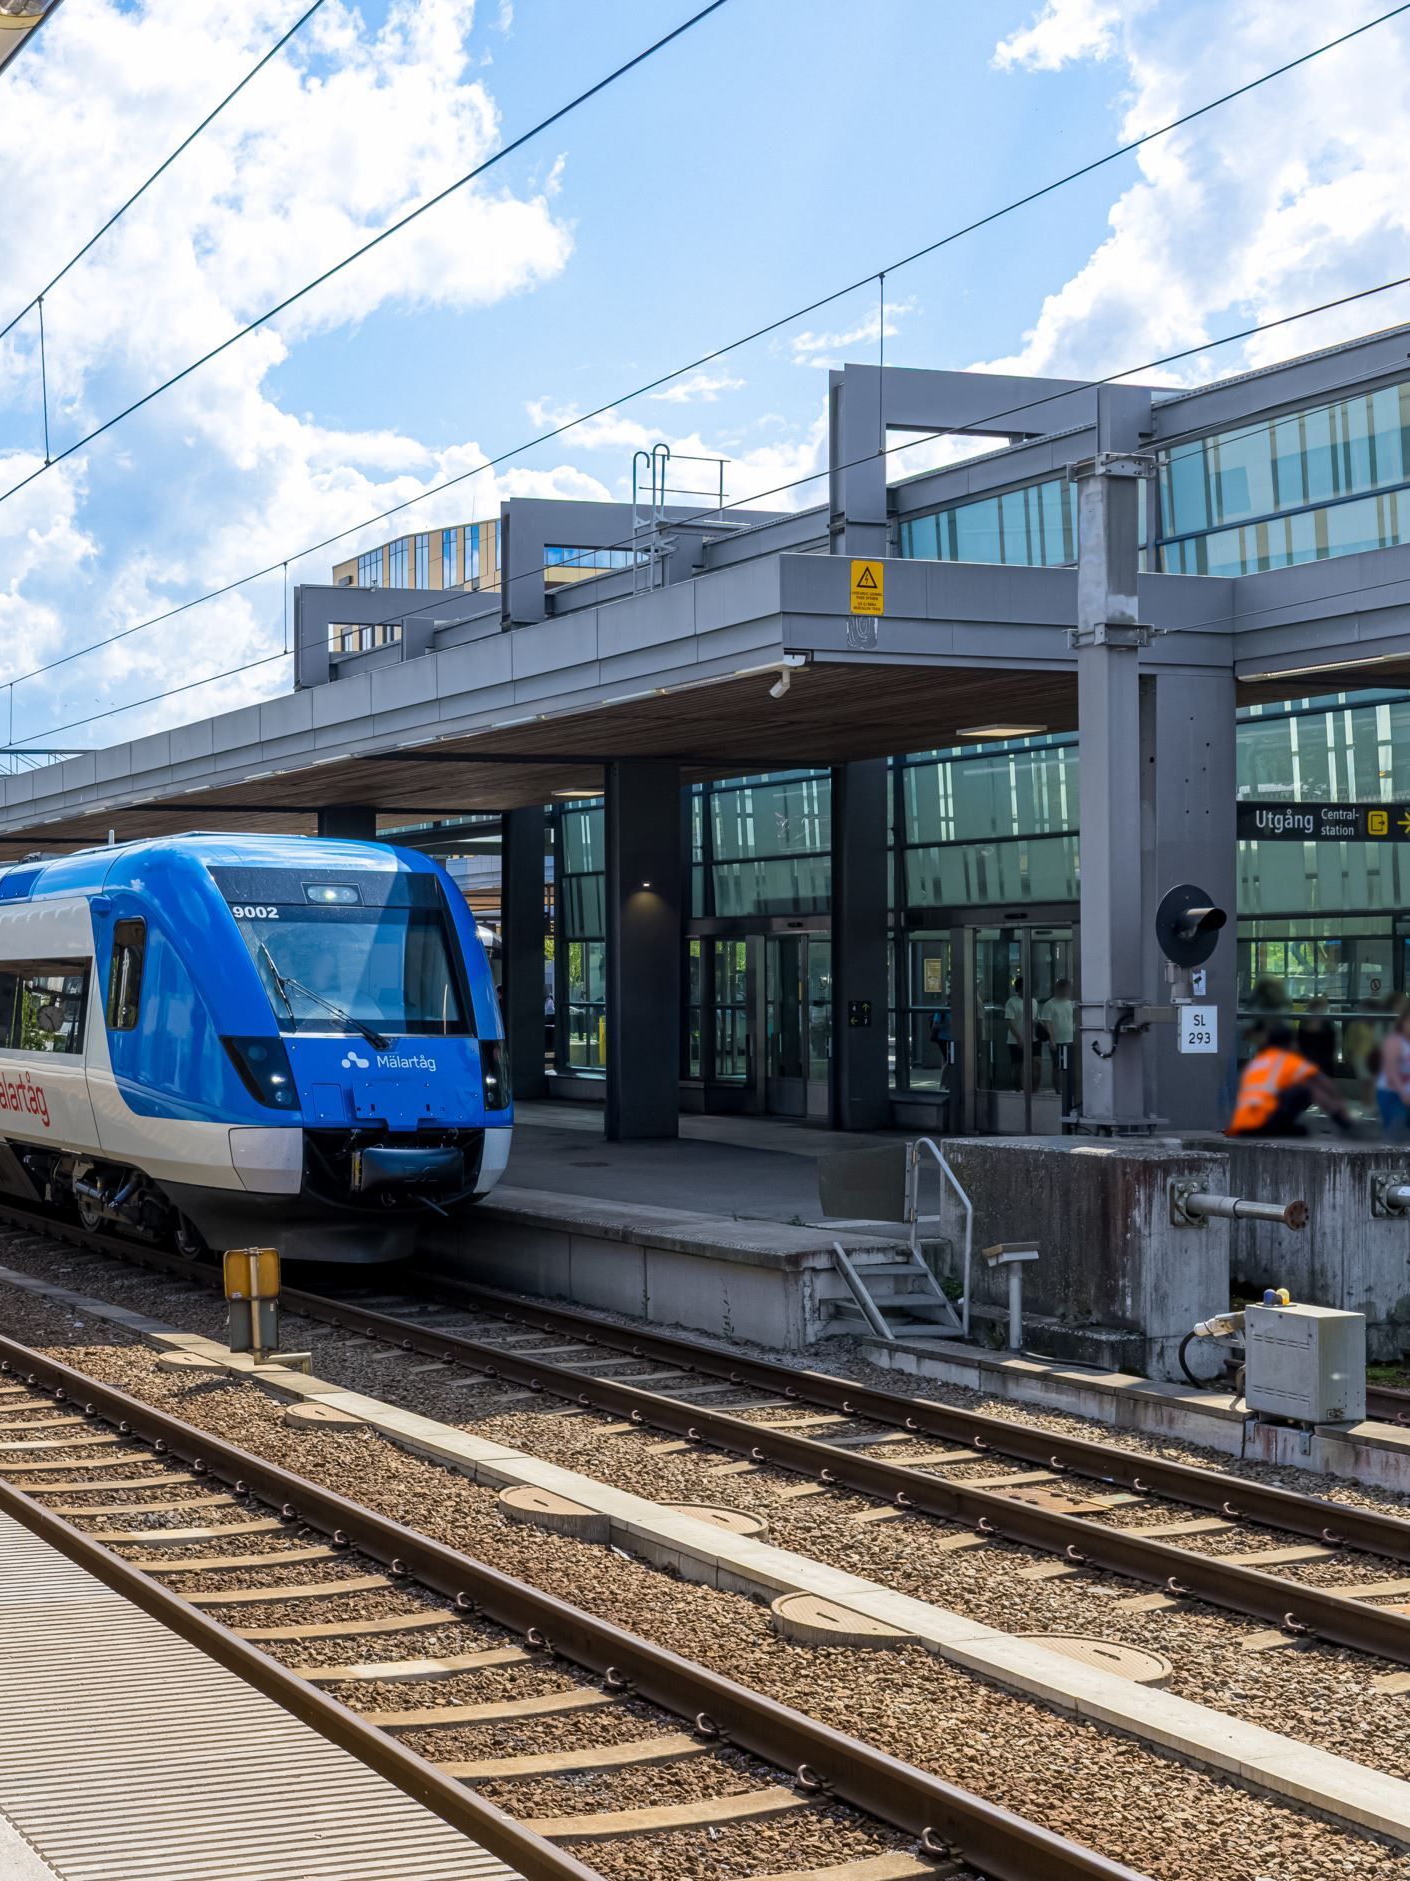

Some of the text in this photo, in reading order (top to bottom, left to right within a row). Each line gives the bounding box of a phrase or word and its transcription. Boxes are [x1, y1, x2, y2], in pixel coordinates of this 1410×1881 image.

[1320, 808, 1360, 821] Central-
[1255, 809, 1314, 834] Utgång
[1320, 824, 1355, 836] station
[232, 906, 280, 919] 9002
[1193, 1014, 1206, 1027] SL
[1188, 1032, 1211, 1045] 293
[376, 1054, 437, 1072] Mälartåg
